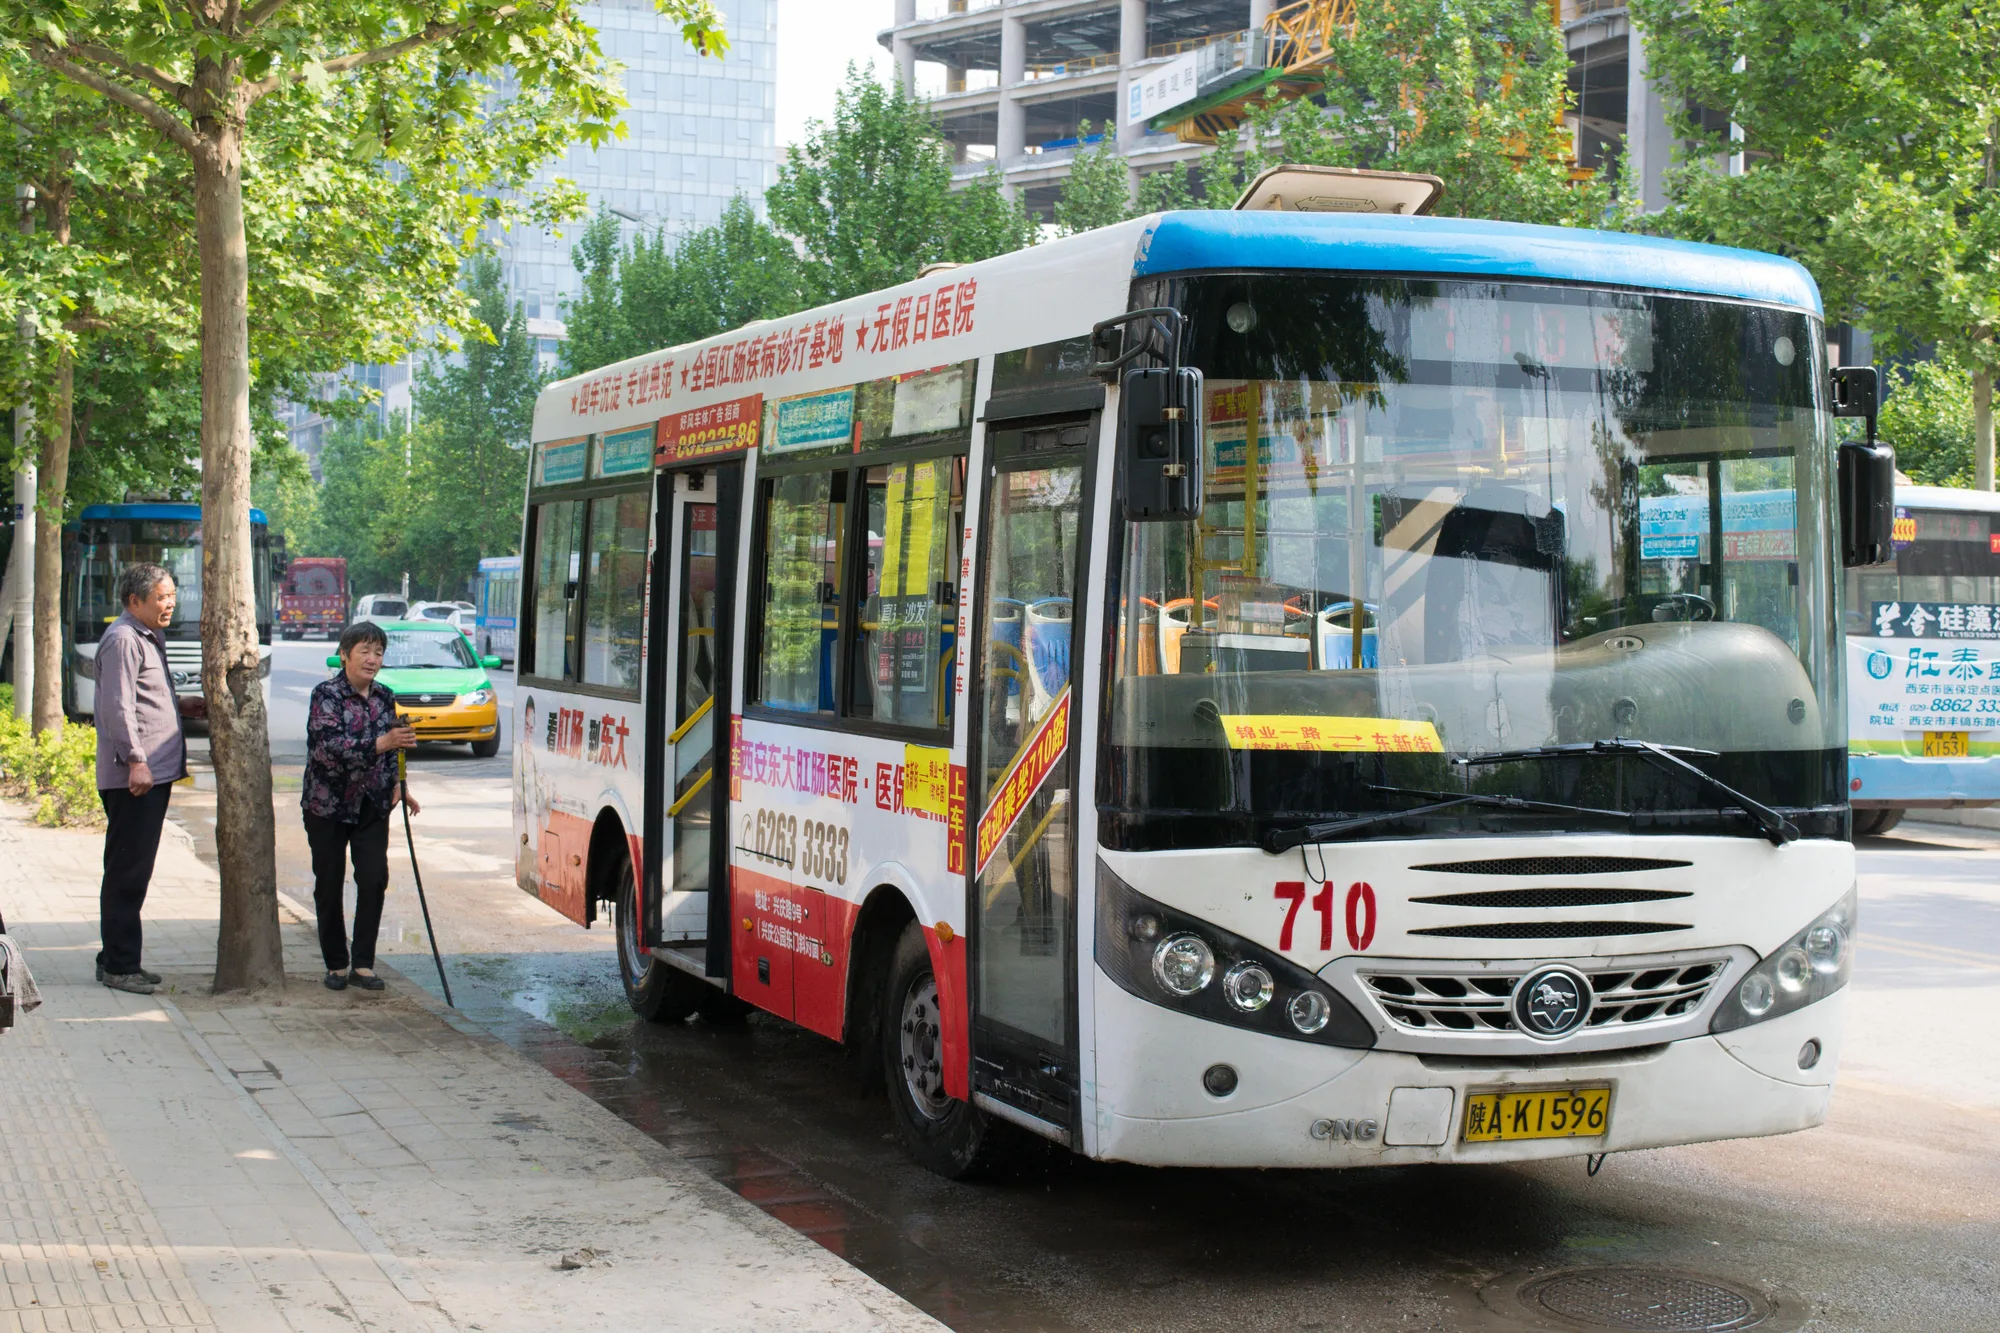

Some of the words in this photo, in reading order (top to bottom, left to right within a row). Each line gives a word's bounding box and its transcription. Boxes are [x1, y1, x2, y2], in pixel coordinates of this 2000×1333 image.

[578, 371, 623, 417] 四年沉淀
[626, 357, 675, 407] 专业典范
[690, 313, 845, 393] 全国肛肠疾病诊疗基地
[871, 277, 978, 354] 无假日医院
[676, 419, 758, 459] 88222586
[955, 527, 972, 697] 严禁三品上车
[546, 706, 585, 761] 看肛肠
[587, 712, 630, 772] 到东大
[731, 719, 742, 799] 下车门
[1235, 725, 1322, 740] 锦业一路
[1371, 732, 1434, 752] 东新街
[1924, 741, 1965, 757] K1531
[979, 706, 1067, 862] 欢迎乘坐710路
[755, 807, 798, 871] 6263
[802, 818, 849, 887] 3333
[949, 771, 965, 871] 上车门
[1274, 880, 1377, 952] 710
[1310, 1118, 1379, 1141] CNG
[1468, 1096, 1604, 1135] 陕A·K1596
